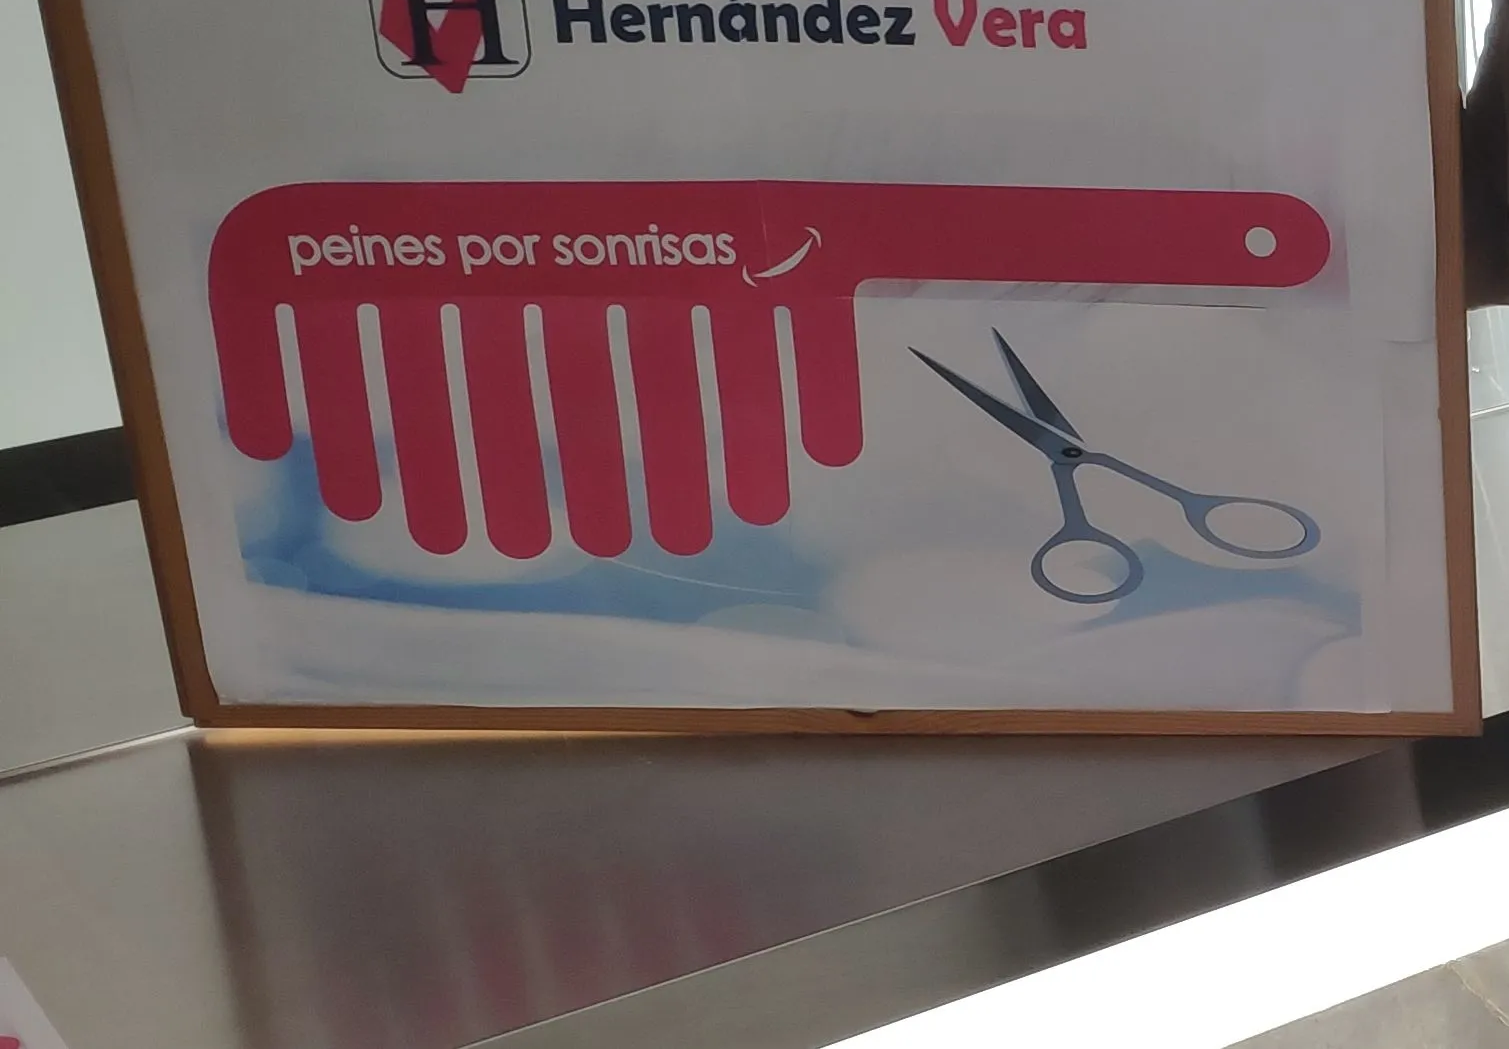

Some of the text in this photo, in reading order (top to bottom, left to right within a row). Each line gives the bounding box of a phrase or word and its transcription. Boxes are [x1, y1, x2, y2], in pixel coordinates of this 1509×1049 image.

[288, 224, 737, 275] peines por sonrisas
